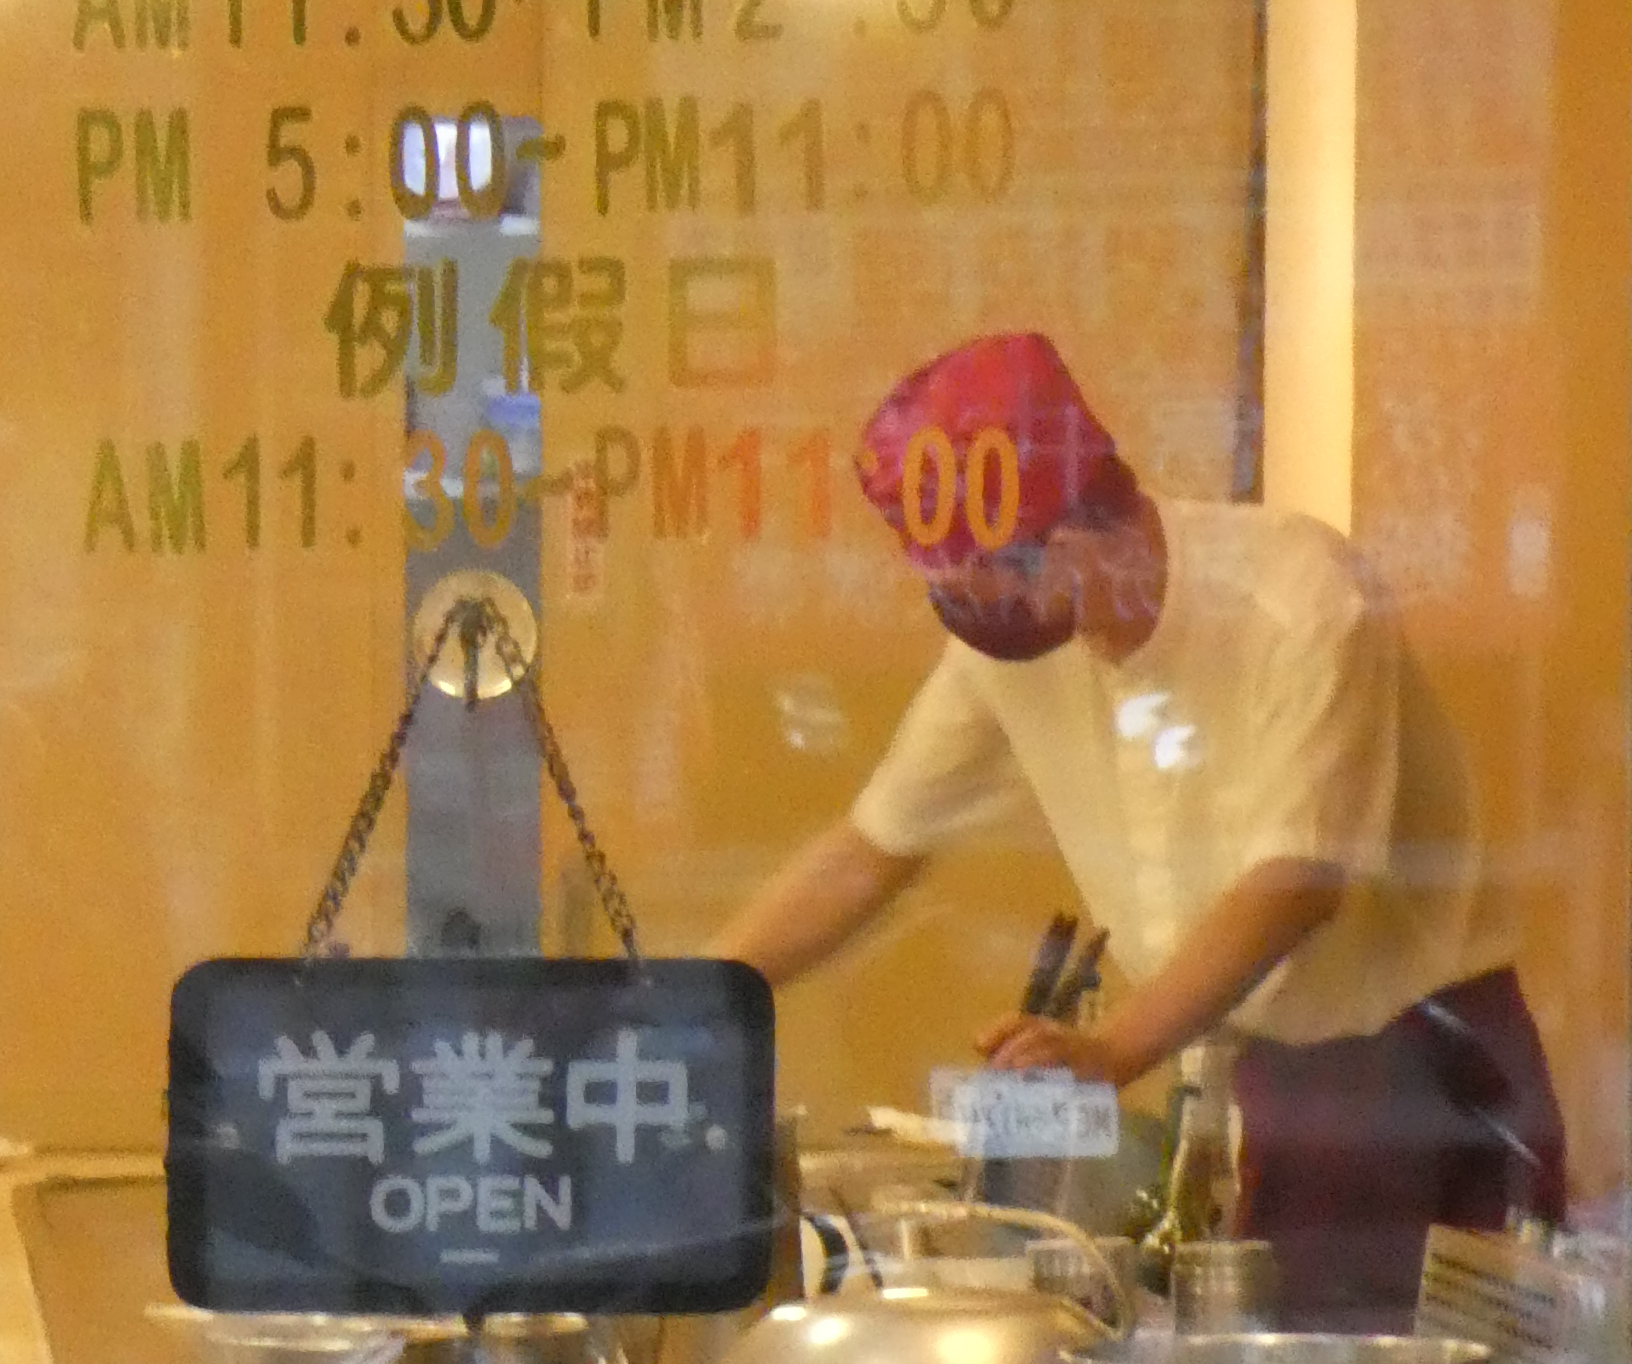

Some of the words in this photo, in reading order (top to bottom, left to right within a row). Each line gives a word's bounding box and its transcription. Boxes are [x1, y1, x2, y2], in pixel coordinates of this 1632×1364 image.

[74, 104, 192, 224] PM
[322, 254, 778, 400] 例假日
[257, 1028, 690, 1168] 營業中
[369, 1174, 571, 1233] OPEN
